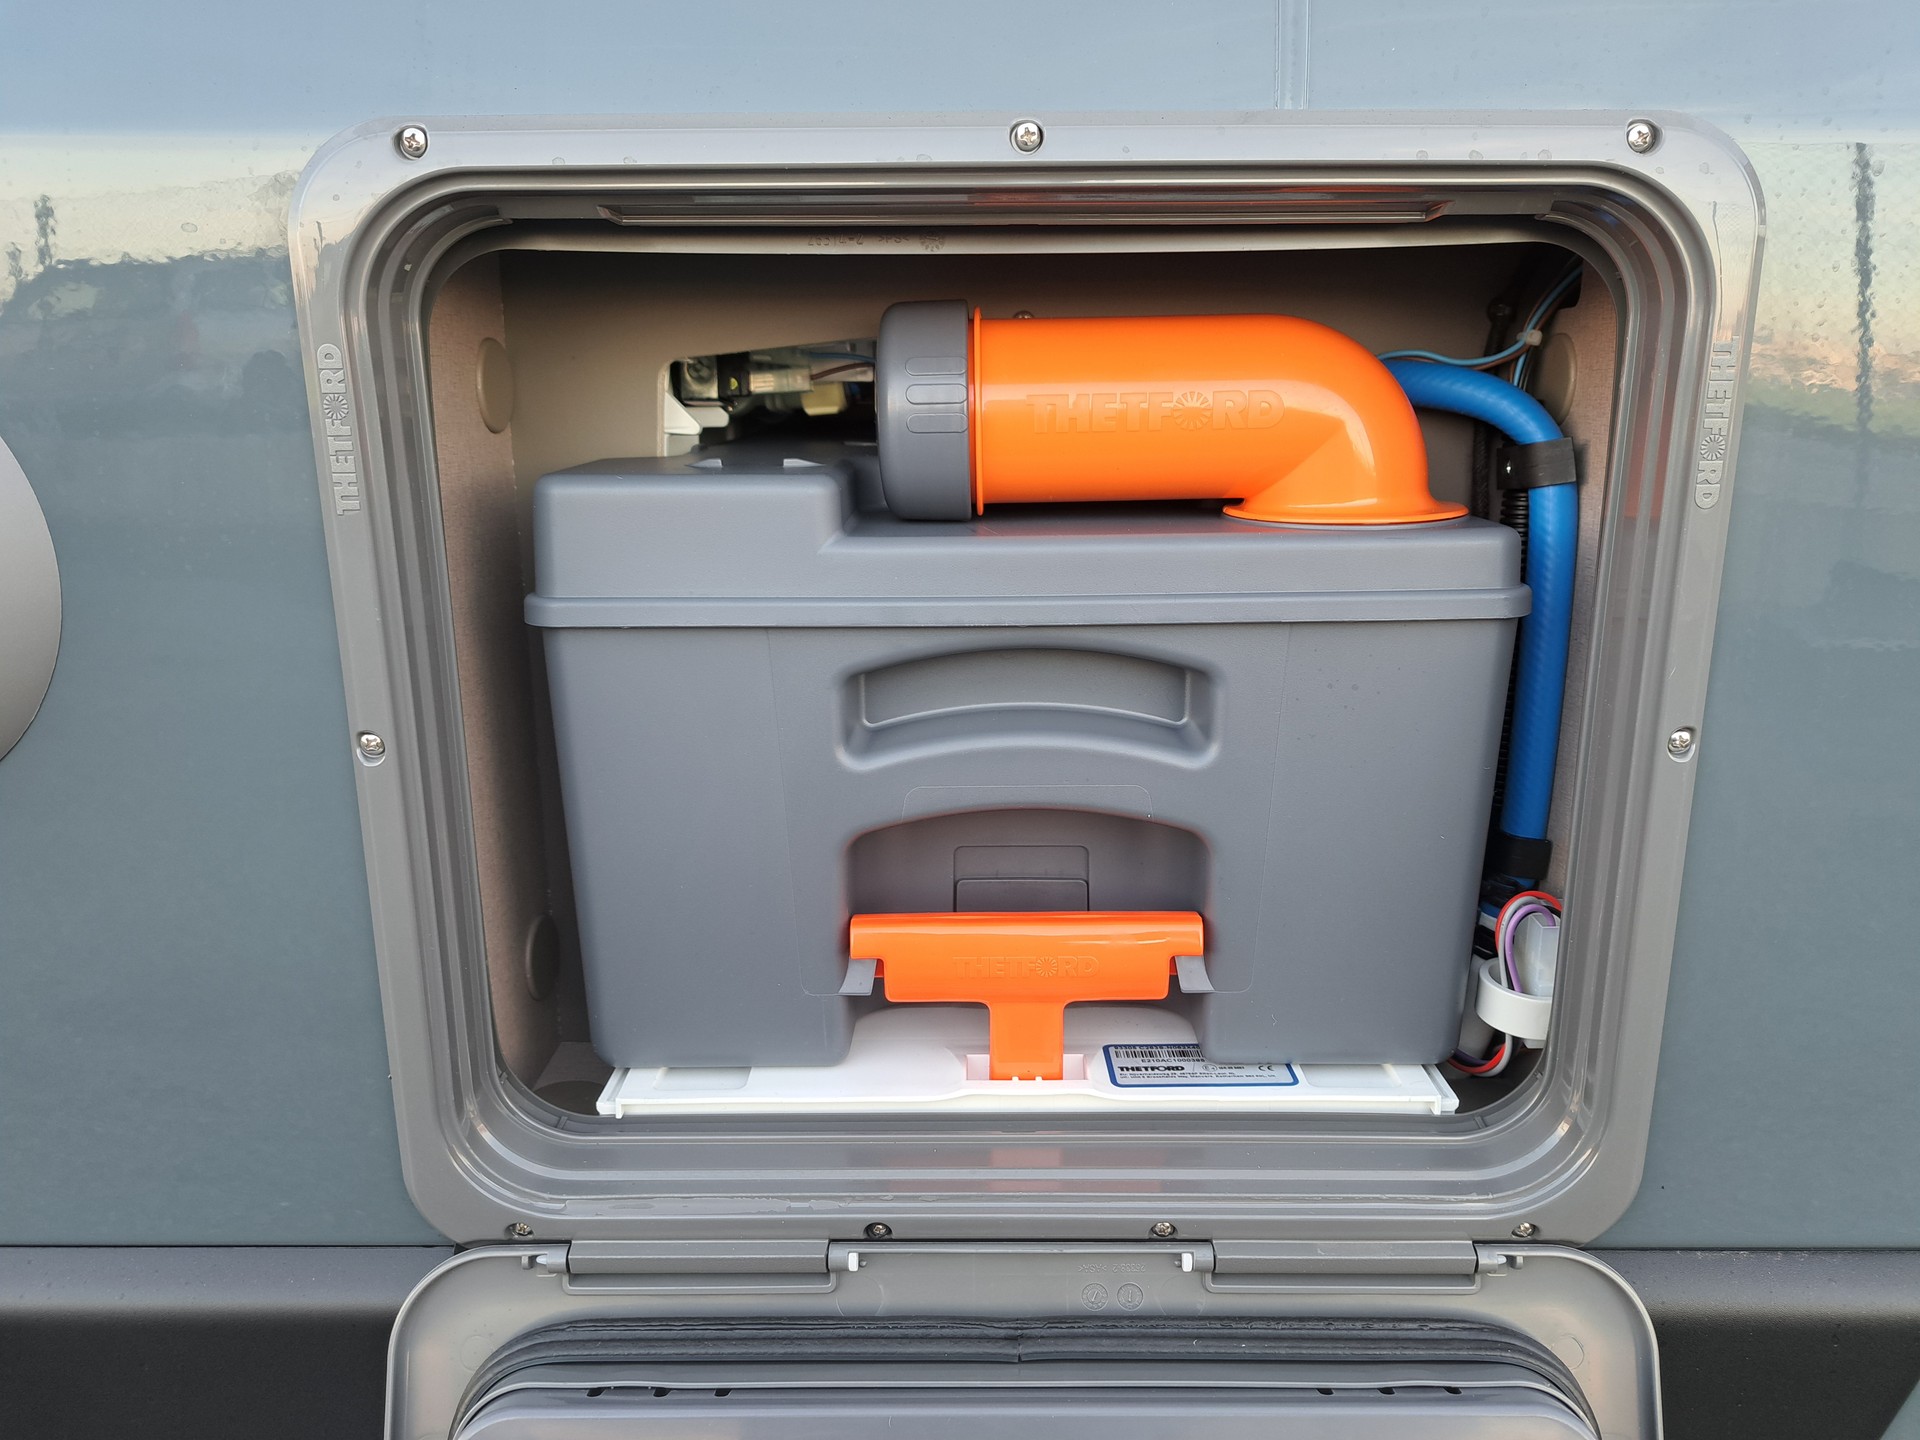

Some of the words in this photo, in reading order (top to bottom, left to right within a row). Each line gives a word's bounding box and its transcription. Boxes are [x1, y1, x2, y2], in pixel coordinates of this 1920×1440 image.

[317, 343, 361, 516] THETFORD
[1026, 389, 1286, 434] THETFORD
[1694, 336, 1740, 509] THETFORD
[952, 956, 1100, 978] THETFORD
